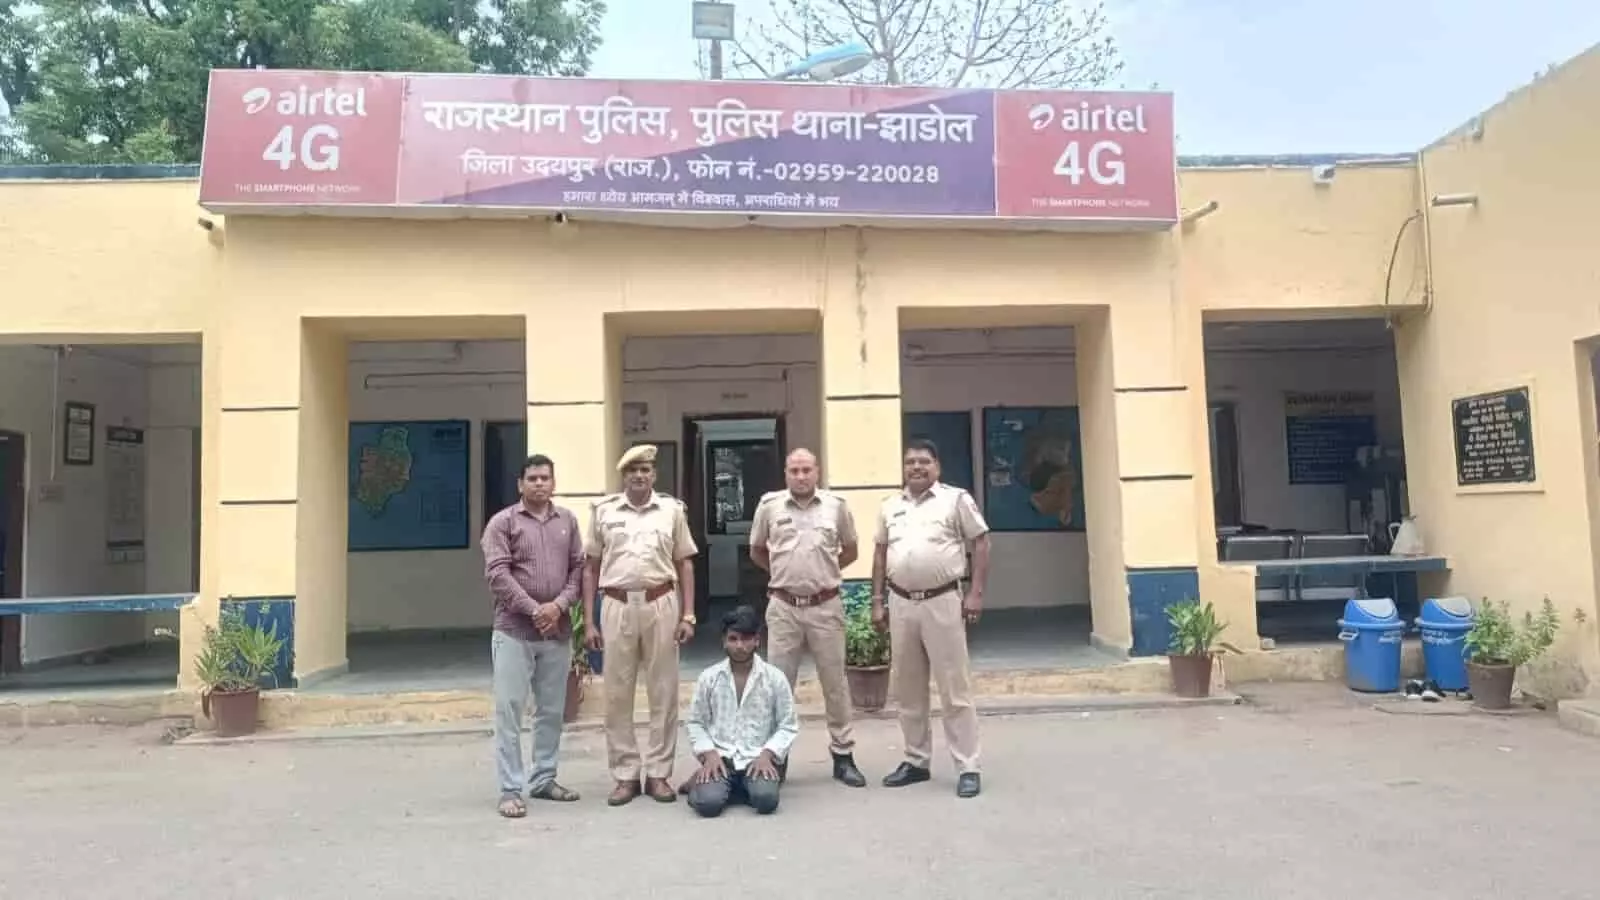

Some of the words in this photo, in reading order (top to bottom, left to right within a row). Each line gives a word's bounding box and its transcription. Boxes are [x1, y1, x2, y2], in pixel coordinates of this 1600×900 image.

[276, 84, 367, 117] airtel
[1061, 101, 1148, 133] airtel
[422, 100, 570, 133] राजस्थान
[576, 95, 679, 144] पुलिस,
[690, 98, 783, 147] पुलिस
[262, 123, 340, 171] 4G
[1053, 140, 1125, 185] 4G
[462, 149, 515, 176] जिला
[521, 155, 600, 183] उदयपुर
[687, 154, 733, 180] फोन
[254, 183, 314, 193] SMARTPHONE
